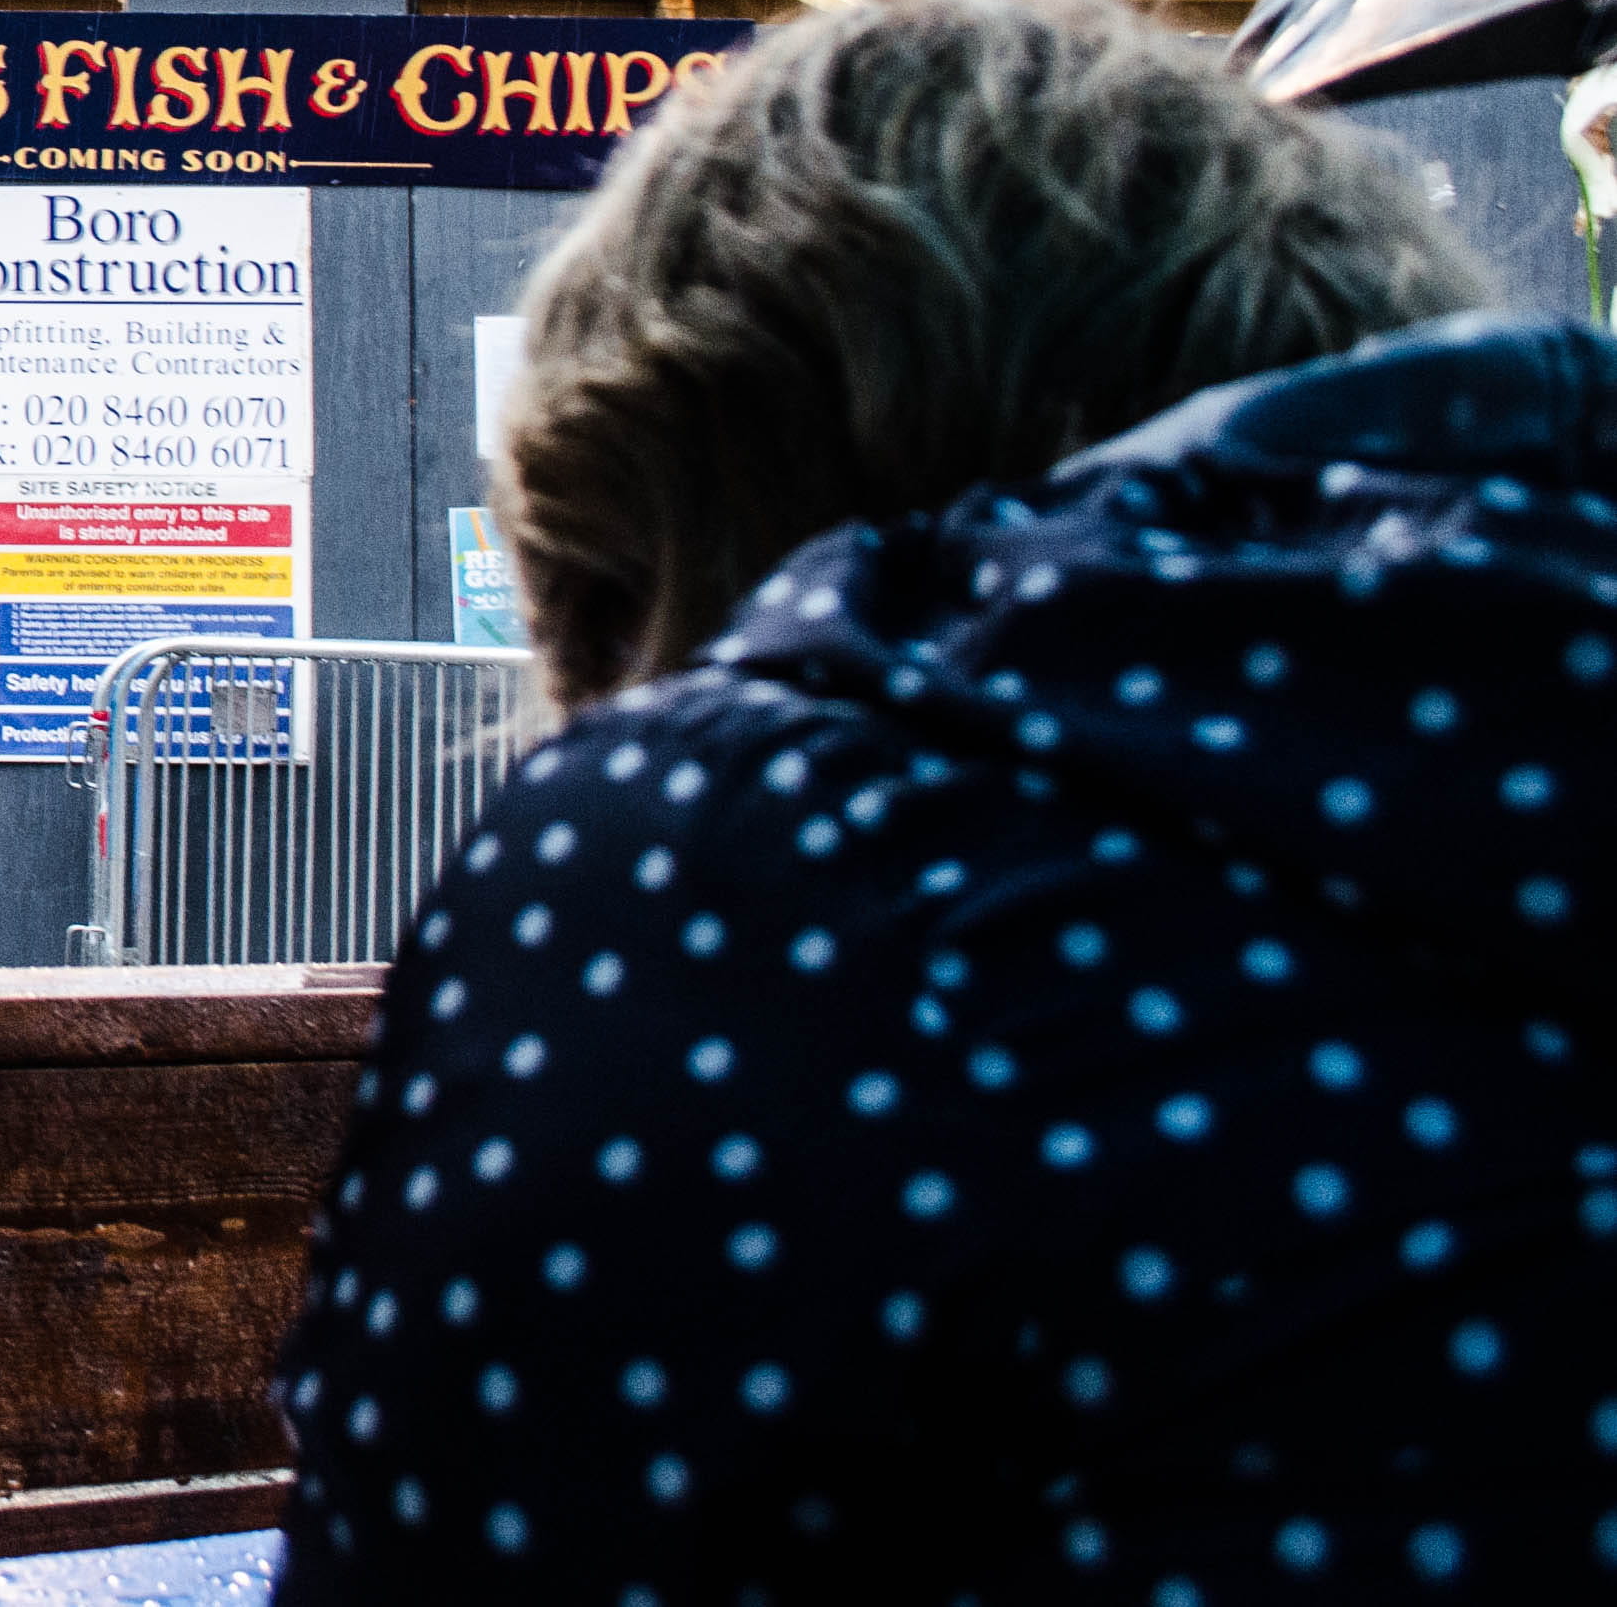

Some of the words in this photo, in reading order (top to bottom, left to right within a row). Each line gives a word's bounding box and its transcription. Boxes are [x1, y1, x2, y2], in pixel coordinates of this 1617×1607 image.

[36, 39, 296, 135] FISH
[308, 57, 368, 119] &
[12, 146, 166, 172] COMING
[181, 148, 288, 174] SOON
[42, 194, 183, 245] Boro
[125, 320, 250, 348] Building
[263, 322, 286, 345] &
[131, 351, 302, 376] Contractors
[24, 395, 88, 426] 020
[102, 395, 188, 427] 8460
[203, 396, 287, 428] 6070
[32, 435, 96, 466] 020
[111, 435, 196, 467] 8460
[211, 436, 290, 469] 6071
[19, 480, 61, 496] SITE
[66, 480, 139, 496] SAFETY
[144, 481, 218, 497] NOTICE
[16, 504, 130, 520] Unauthorised
[133, 506, 178, 524] entry
[180, 506, 200, 521] to
[201, 506, 235, 522] this
[237, 506, 271, 522] site
[58, 524, 76, 540] is
[78, 525, 137, 543] strictly
[139, 525, 228, 543] prohibited
[24, 553, 81, 565] WARNING
[84, 554, 179, 565] CONSTRUCTION
[197, 555, 264, 566] PROGRESS
[5, 673, 68, 696] Safety
